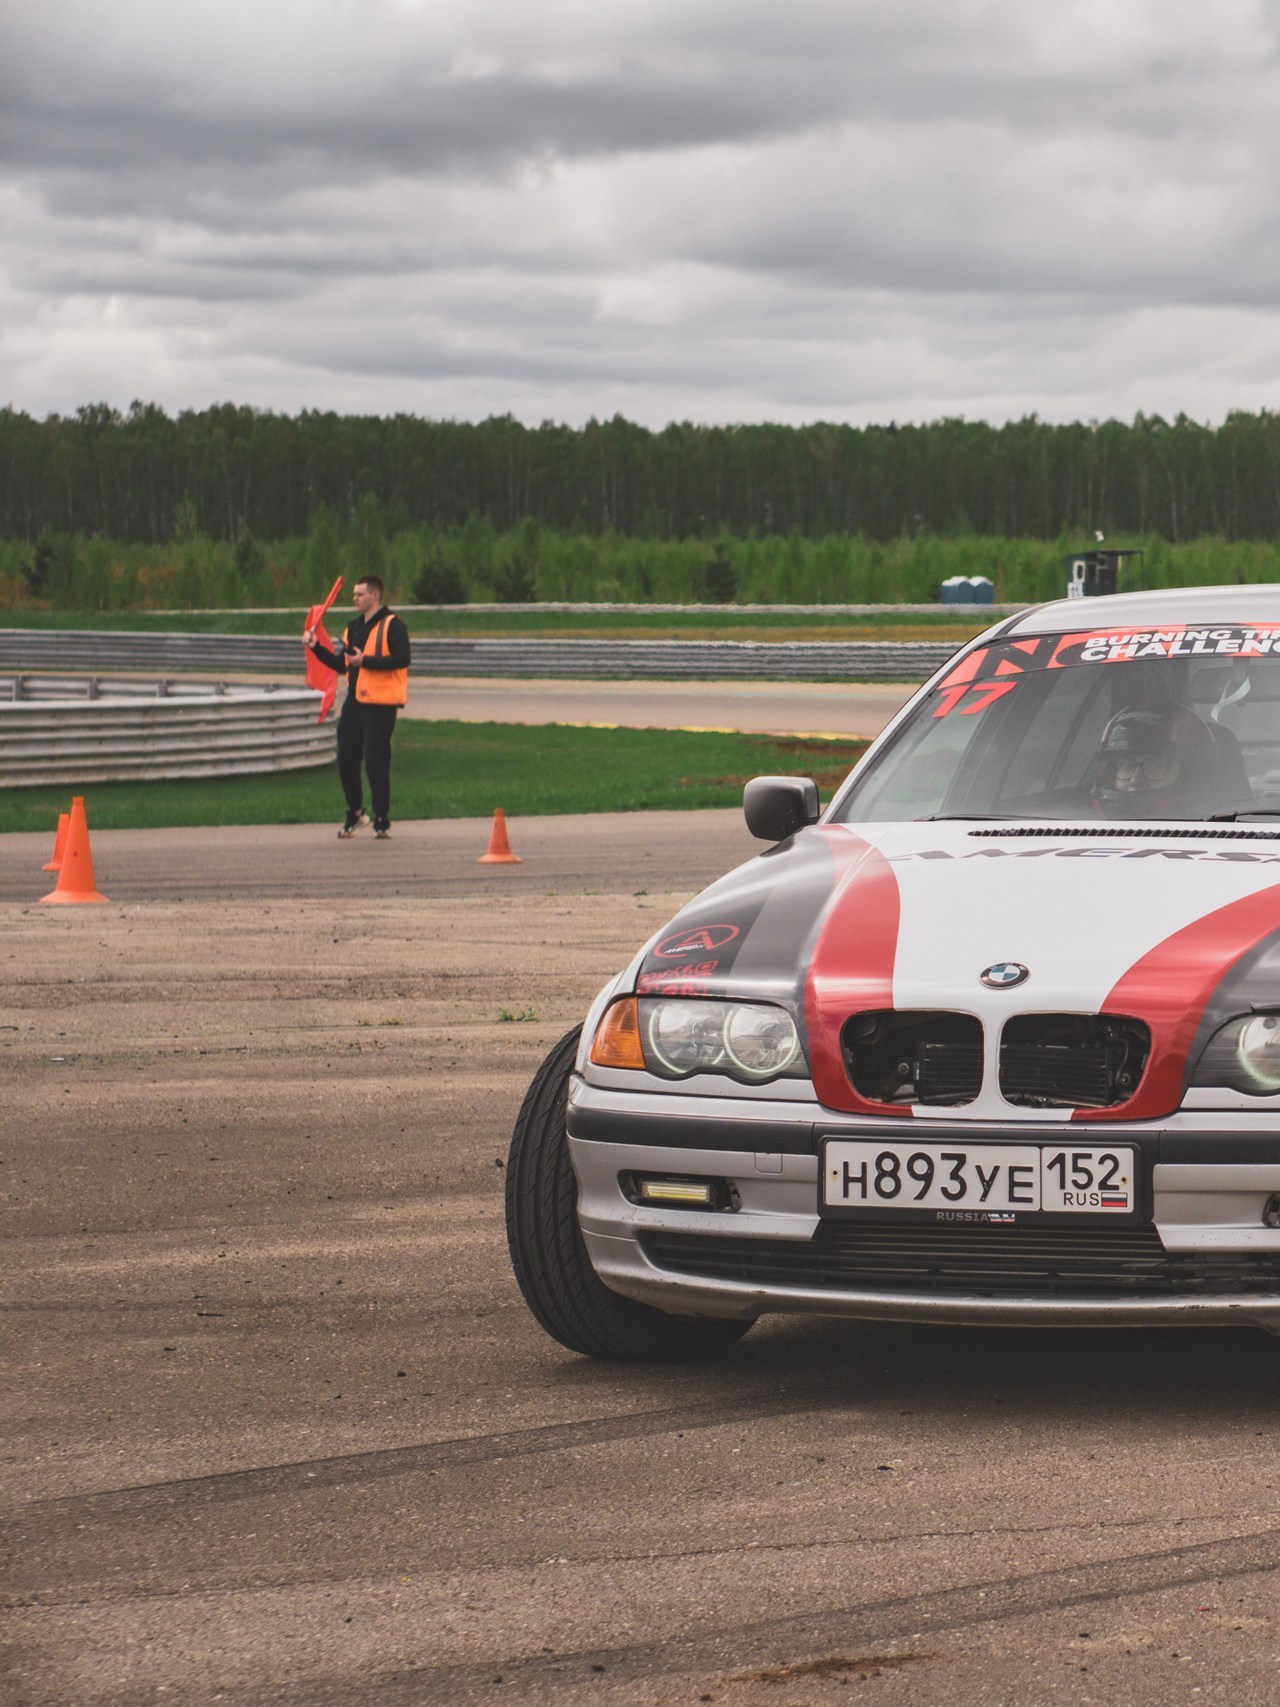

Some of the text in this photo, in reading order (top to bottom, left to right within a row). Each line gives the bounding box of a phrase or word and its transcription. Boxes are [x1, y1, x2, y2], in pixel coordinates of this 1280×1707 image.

[1084, 629, 1233, 649] BURNING
[932, 681, 1018, 719] 17
[1046, 1152, 1120, 1191] 152
[1063, 1192, 1099, 1206] RUS
[936, 1211, 991, 1222] RUSSIA
